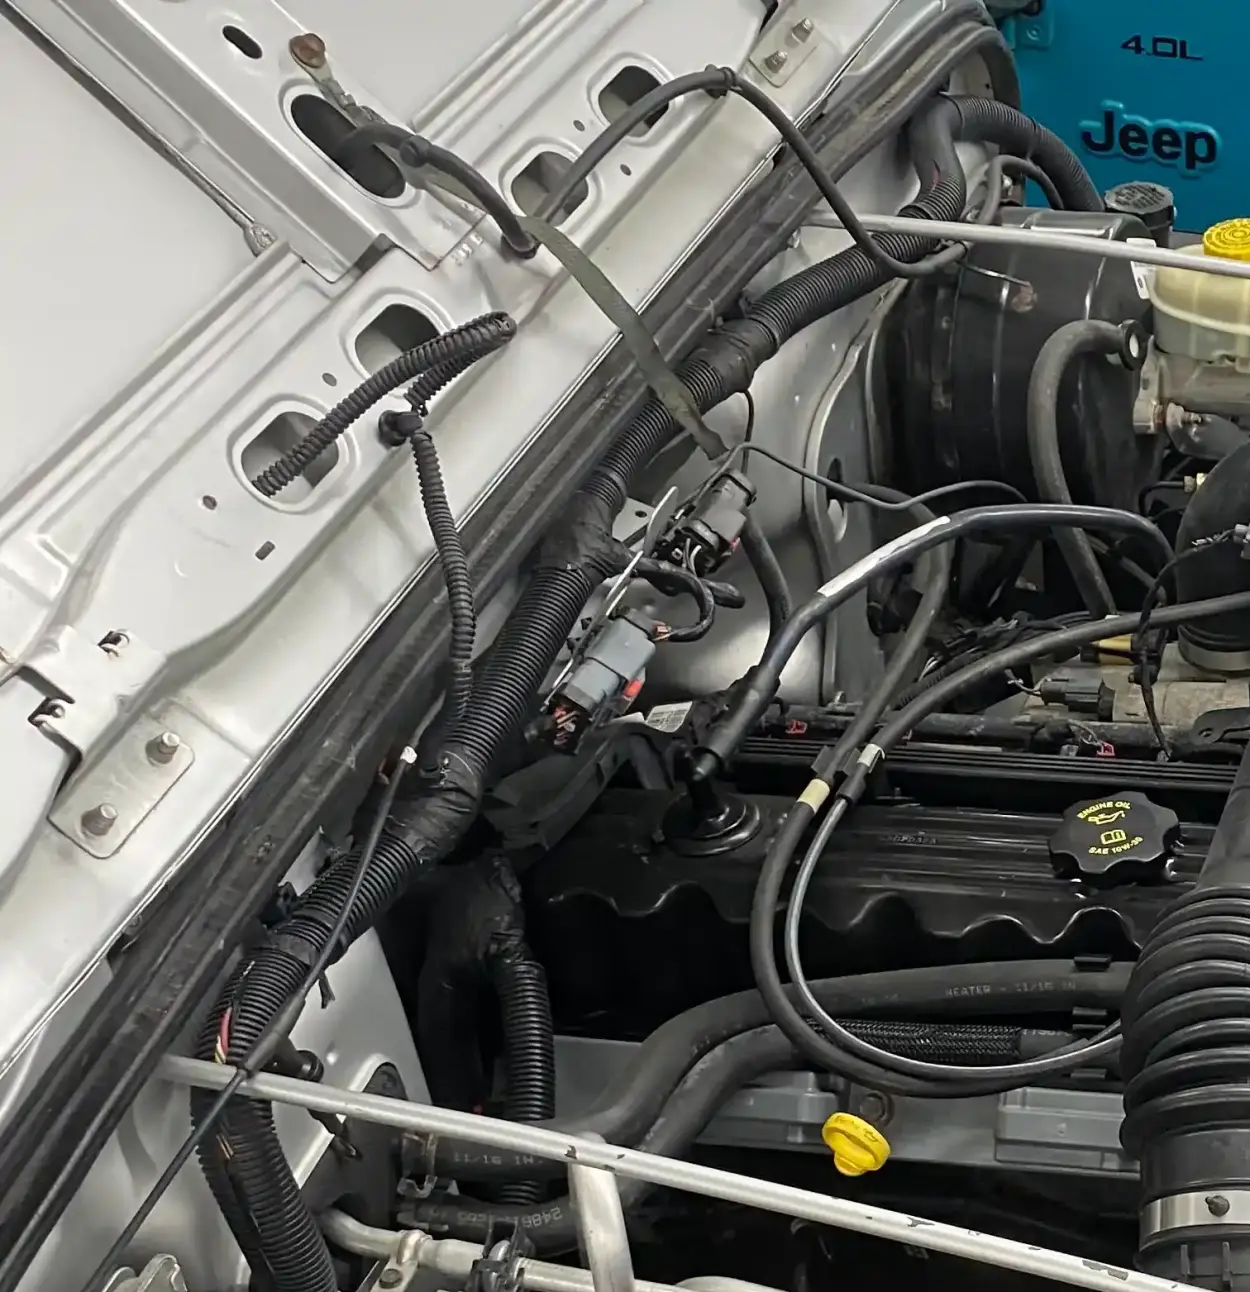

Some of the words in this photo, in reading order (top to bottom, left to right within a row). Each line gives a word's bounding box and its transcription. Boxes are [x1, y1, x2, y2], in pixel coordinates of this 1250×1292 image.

[1120, 34, 1203, 61] 4.0L
[1082, 109, 1217, 170] Jeep
[1076, 801, 1113, 818] ENGINE
[1114, 801, 1131, 809] OIL
[1088, 846, 1109, 854] SAE
[945, 984, 992, 997] HEATER
